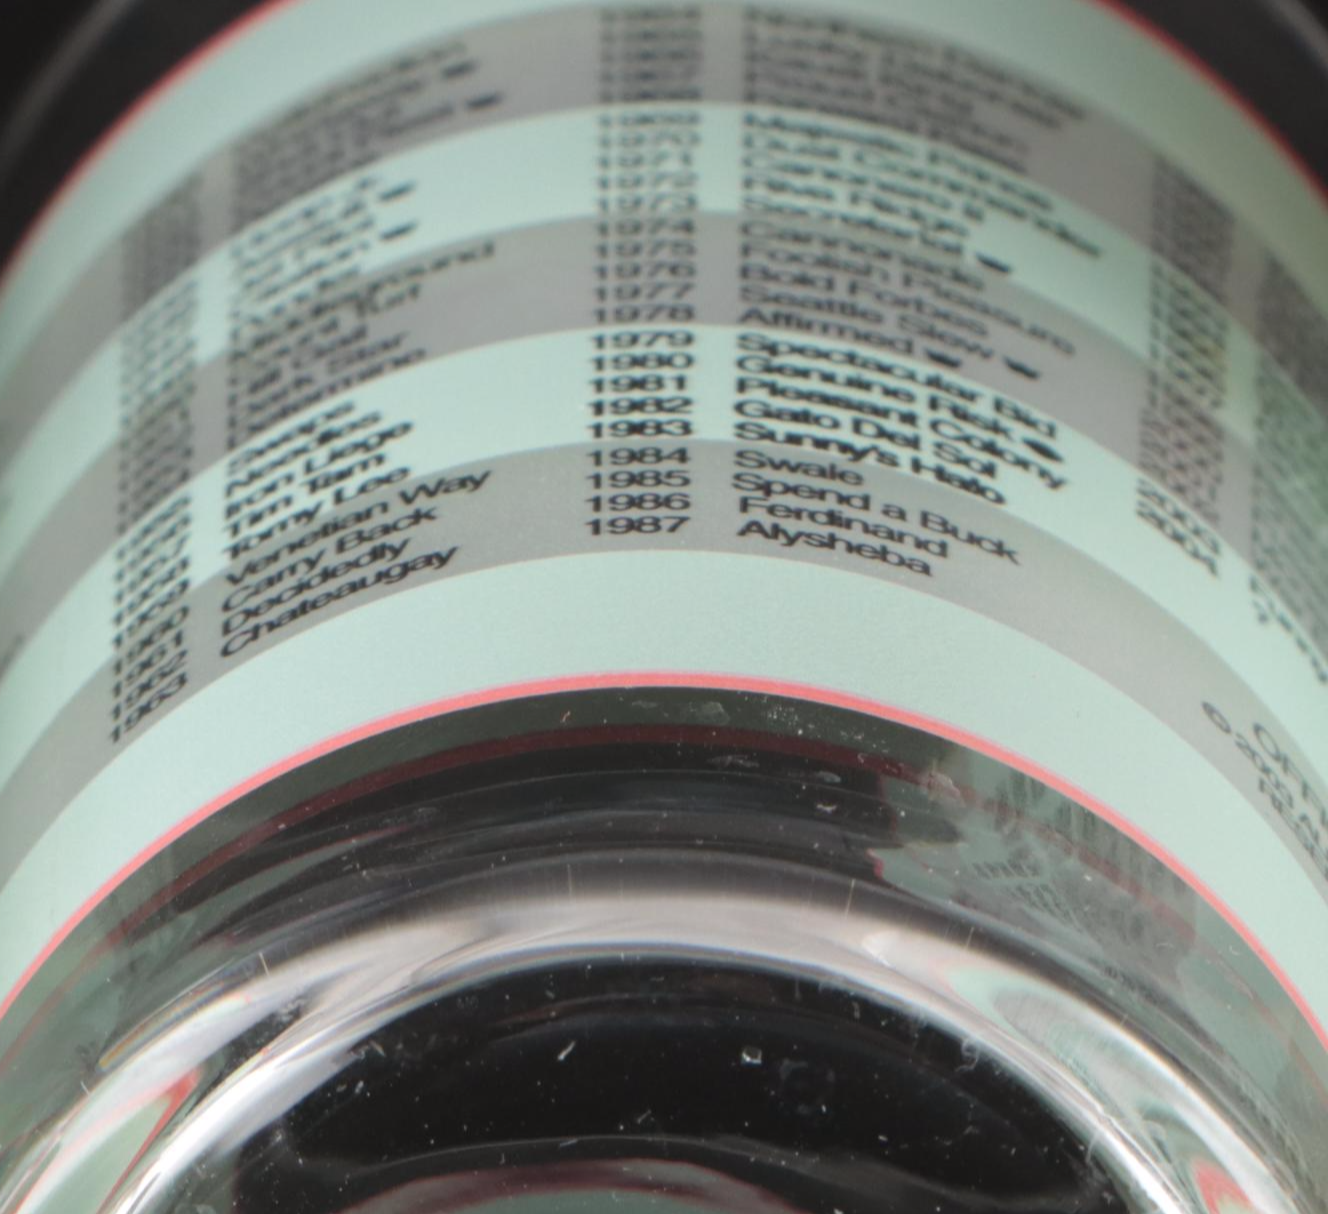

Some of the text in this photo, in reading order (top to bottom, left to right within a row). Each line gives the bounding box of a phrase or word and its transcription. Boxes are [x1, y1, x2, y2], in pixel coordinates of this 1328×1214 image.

[592, 281, 697, 302] 1977
[739, 283, 884, 325] Seattle
[739, 263, 836, 293] Bold
[591, 303, 915, 357] 1978 Affirmed
[588, 351, 1014, 442] 1980 Genuine Risk
[589, 329, 1058, 440] 1979 Spectacular Bid
[225, 411, 383, 498] Needles
[225, 472, 297, 519] Iron
[304, 420, 415, 477] Liege
[586, 418, 1008, 506] 1983 Sunny's Halo
[586, 445, 864, 487] 1984 Swale
[587, 373, 1070, 491] 1981 Pleasant Colony
[587, 395, 997, 481] 1982 Gato Del Sol
[222, 493, 296, 539] Tim
[302, 451, 388, 494] Tam
[222, 500, 325, 560] Tomy
[335, 464, 410, 504] Lee
[225, 500, 389, 584] Venetian
[398, 468, 492, 506] Way
[584, 491, 949, 559] 1986 Ferdinand
[585, 468, 1021, 567] 1985 Spend a Buck
[221, 547, 327, 613] Carry
[335, 506, 439, 554] Back
[221, 537, 411, 637] Decidedly
[583, 515, 933, 577] 1987 Alysheba
[110, 545, 461, 743] 1963 Chateaugay
